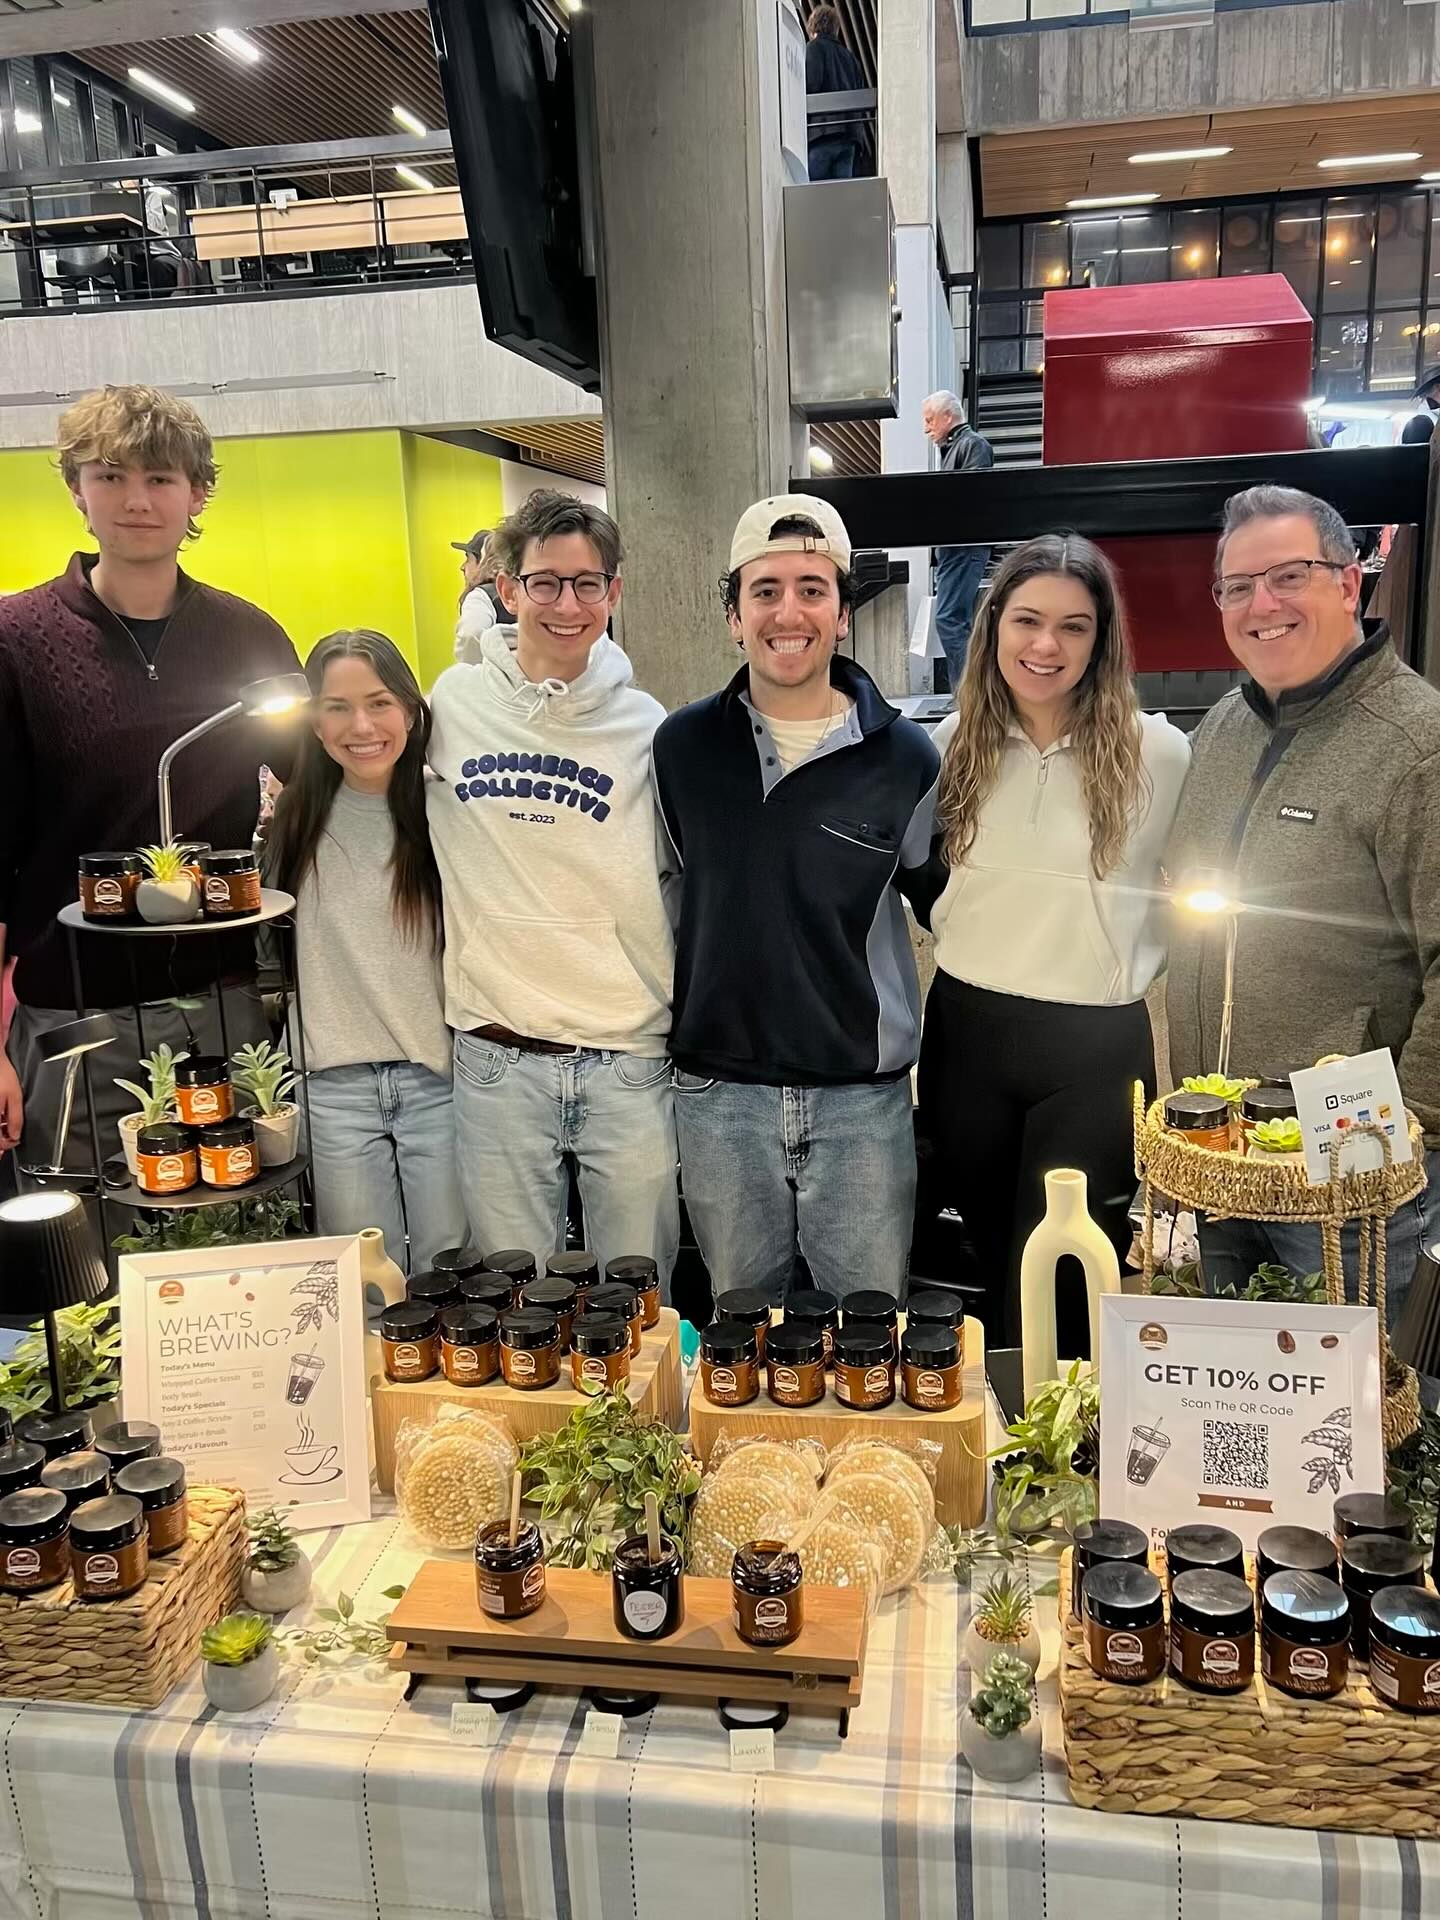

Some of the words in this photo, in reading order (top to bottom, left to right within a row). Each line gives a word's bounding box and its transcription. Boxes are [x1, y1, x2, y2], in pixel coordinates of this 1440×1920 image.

[462, 752, 614, 796] COMMERCE
[455, 777, 611, 822] COLLECTIVE
[529, 813, 556, 824] 2023
[1340, 1088, 1373, 1105] Square
[1314, 1124, 1331, 1133] VISA
[158, 1310, 253, 1336] WHAT'S
[160, 1328, 291, 1357] BREWING?
[161, 1363, 191, 1373] Today's
[192, 1361, 216, 1369] Menu
[194, 1376, 218, 1385] Coffee
[1144, 1363, 1199, 1386] GET
[1206, 1368, 1259, 1391] 10%
[1267, 1373, 1326, 1396] OFF
[161, 1393, 180, 1401] Body
[161, 1404, 192, 1413] Today's
[193, 1400, 226, 1410] Specials
[1181, 1397, 1211, 1411] Scan
[1215, 1400, 1236, 1412] The
[1239, 1402, 1257, 1415] QR
[1260, 1404, 1294, 1417] Code
[183, 1417, 207, 1425] Coffee
[162, 1443, 193, 1453] Today's
[194, 1440, 229, 1449] Flavours
[1226, 1499, 1245, 1508] AND
